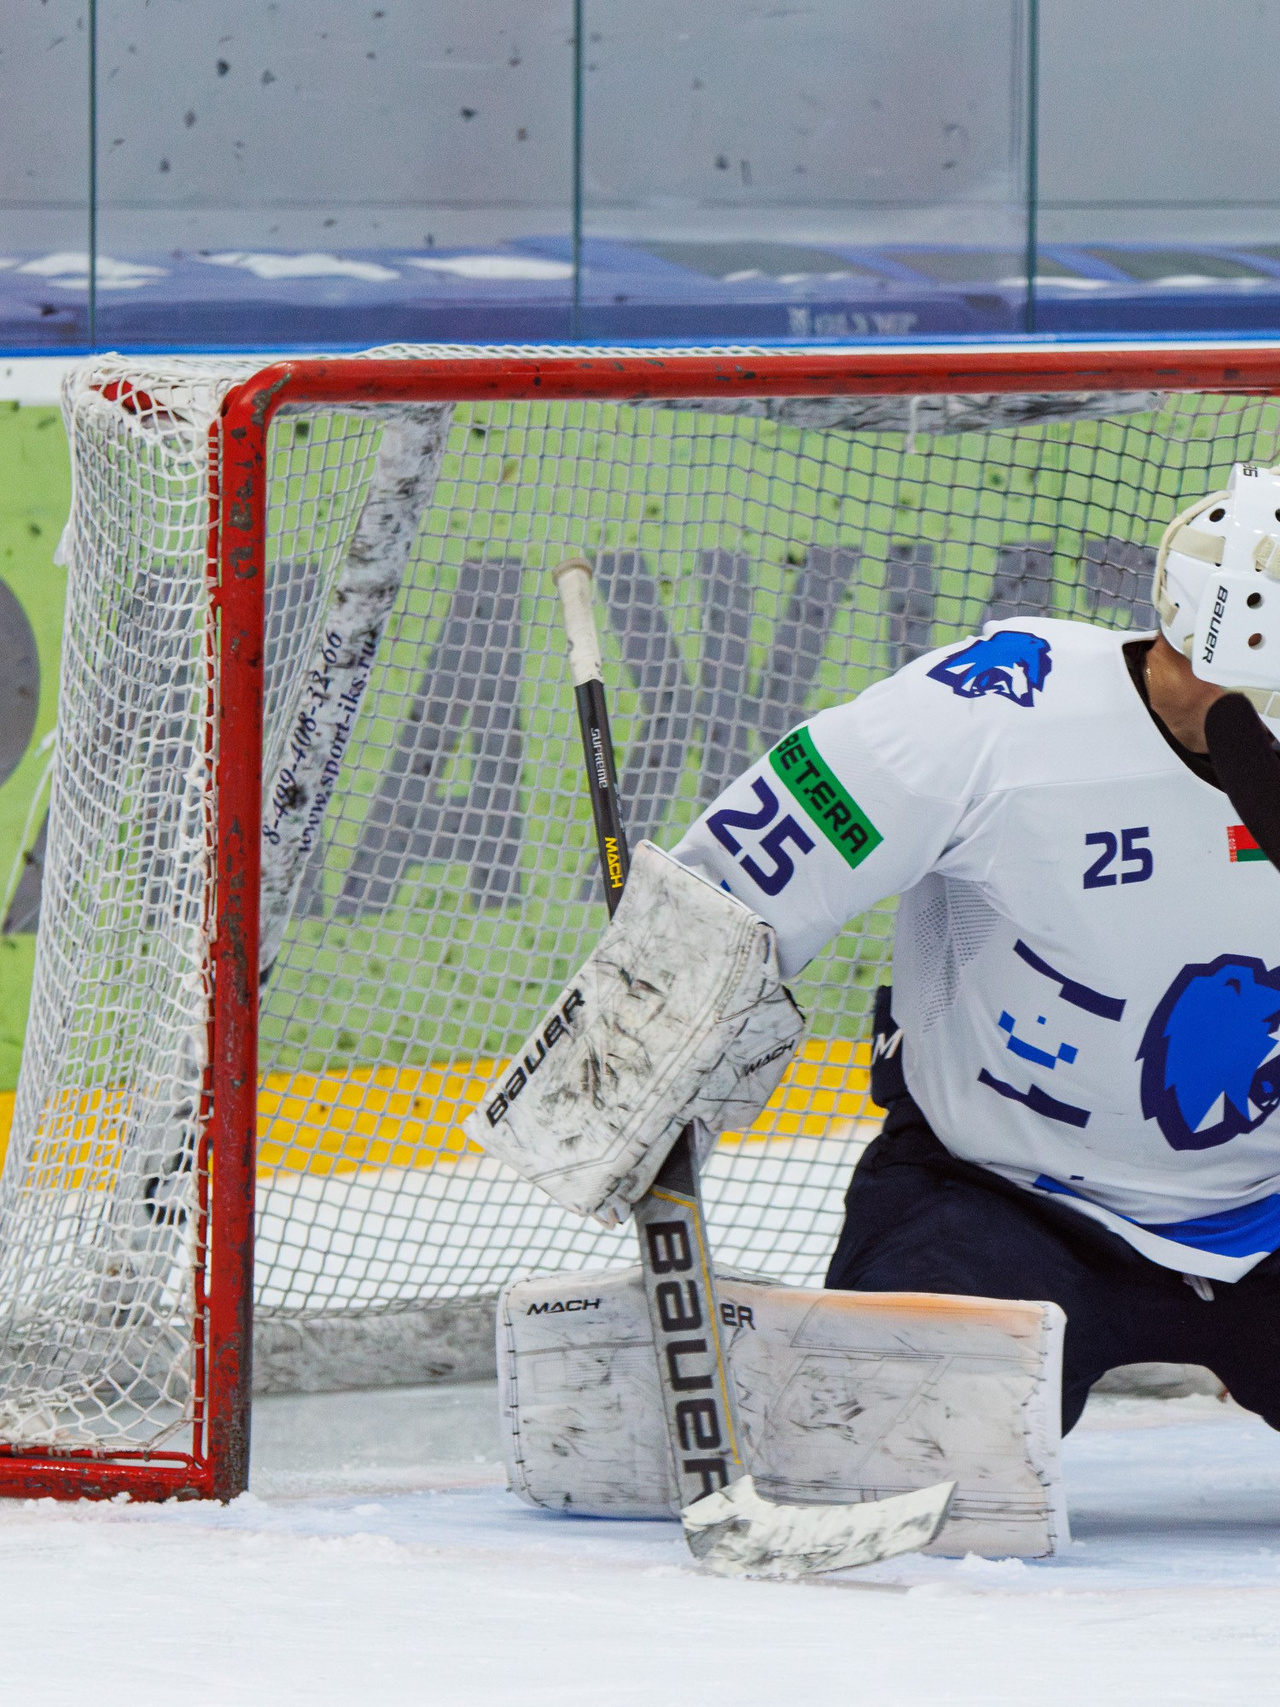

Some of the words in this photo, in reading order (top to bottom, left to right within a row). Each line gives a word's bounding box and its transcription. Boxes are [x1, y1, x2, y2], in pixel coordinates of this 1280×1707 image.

[1201, 585, 1229, 664] BAUER
[777, 732, 869, 855] BETERA
[604, 836, 624, 889] MACH
[705, 775, 816, 896] 25
[1083, 826, 1153, 890] 25
[485, 988, 586, 1128] BAUER
[526, 1298, 602, 1317] MACH
